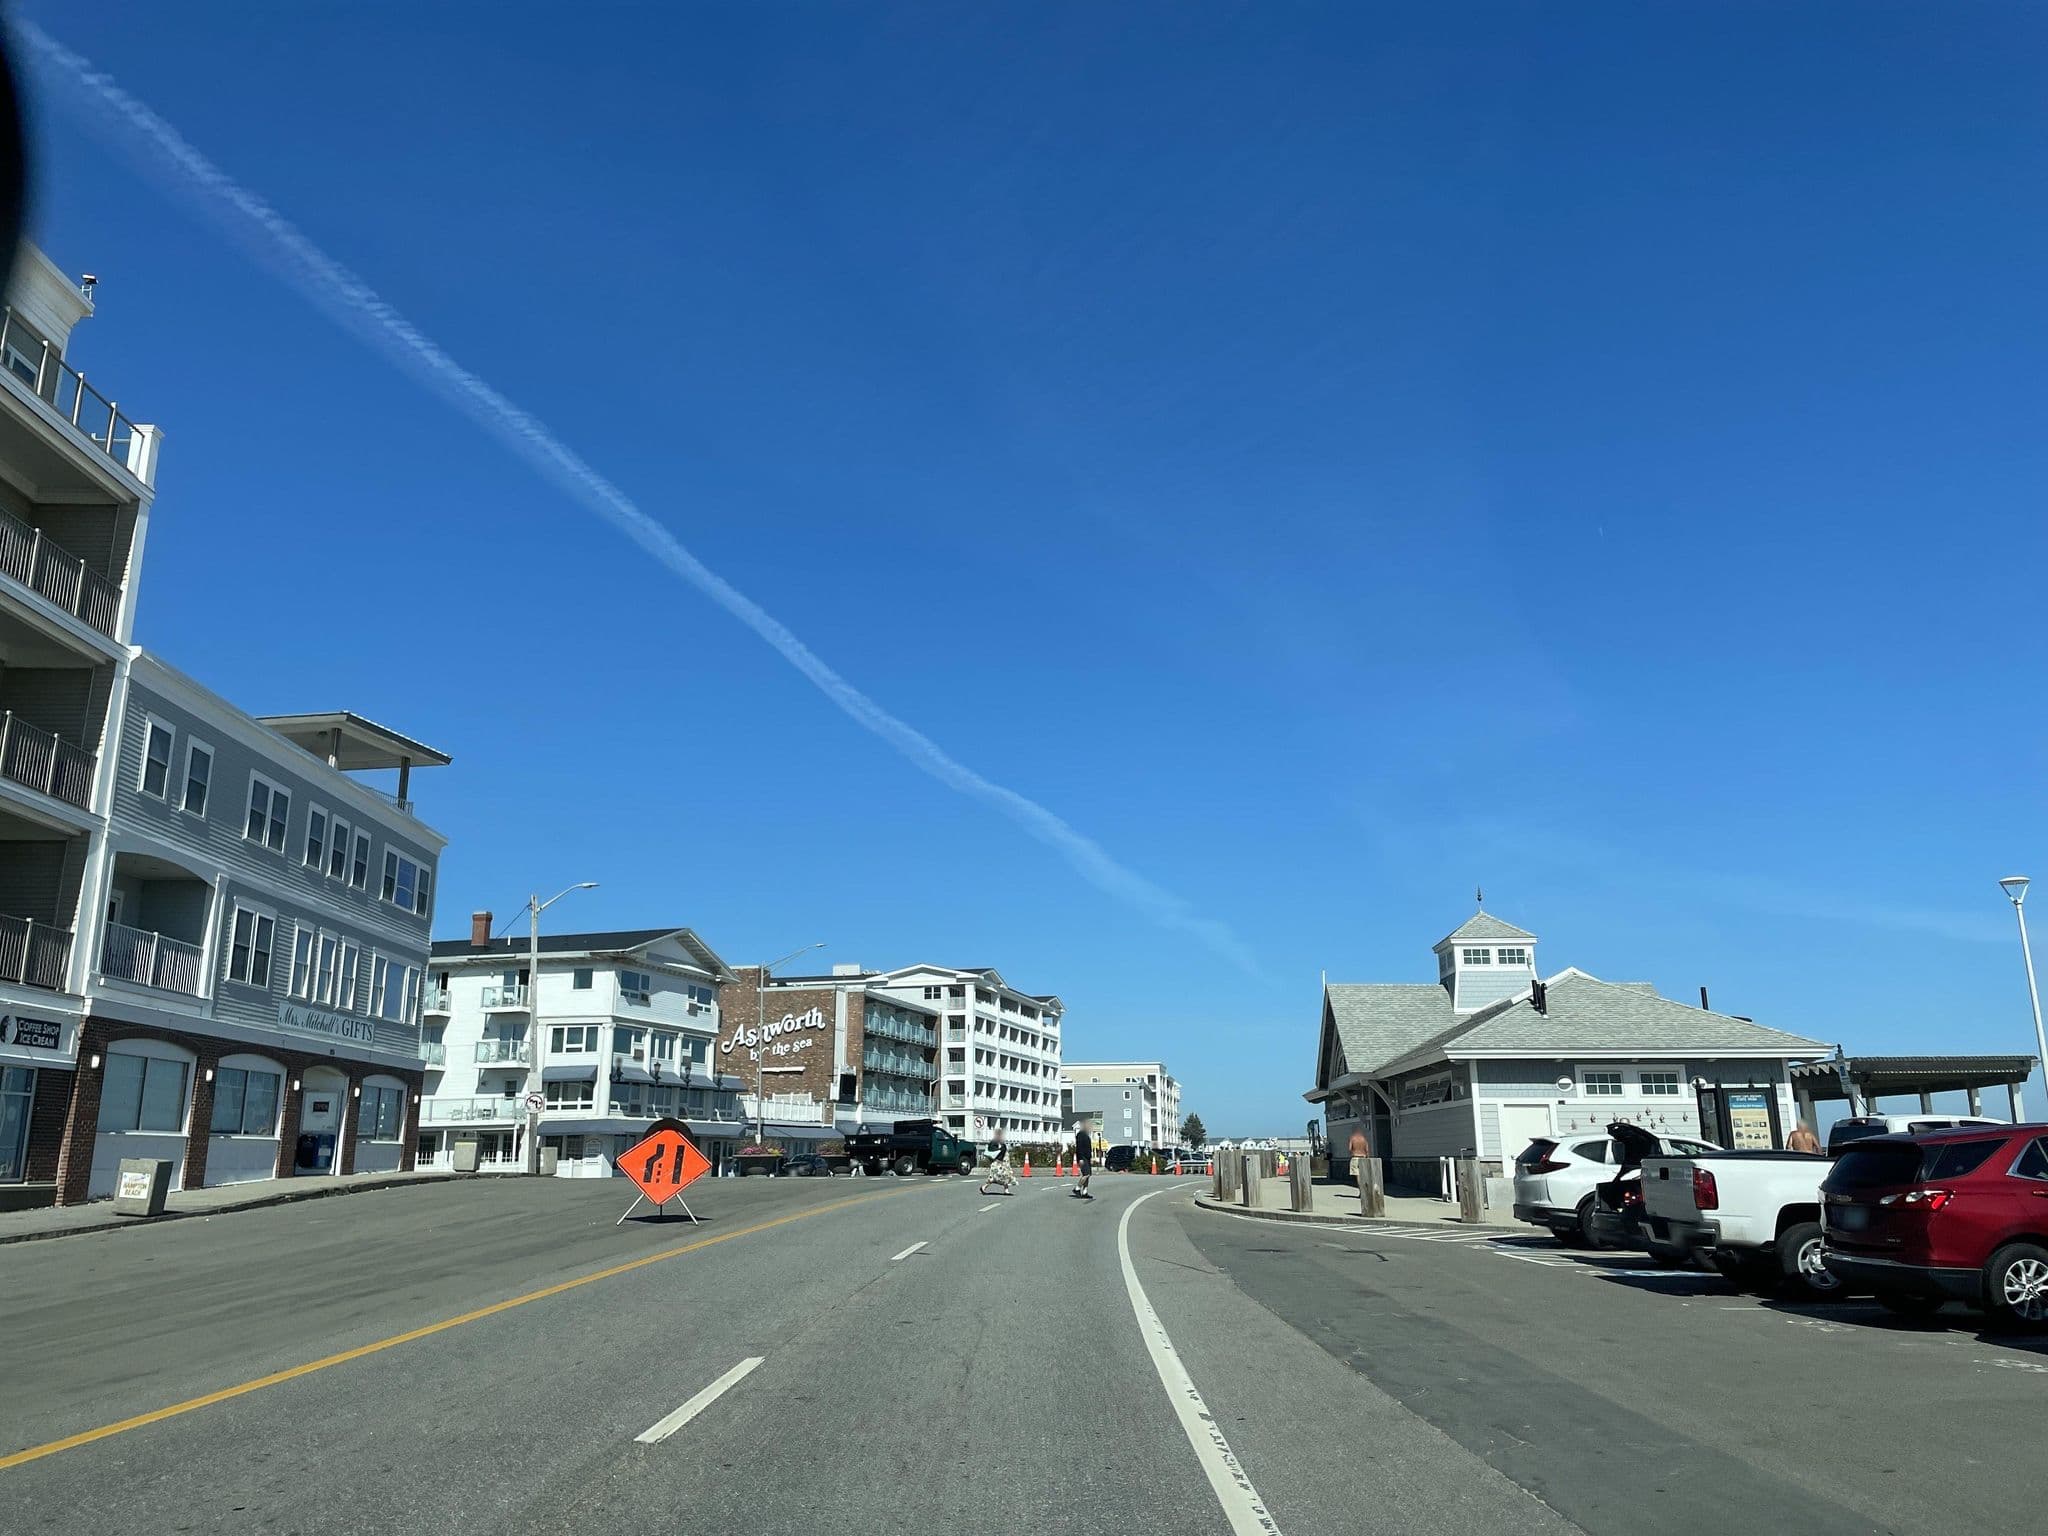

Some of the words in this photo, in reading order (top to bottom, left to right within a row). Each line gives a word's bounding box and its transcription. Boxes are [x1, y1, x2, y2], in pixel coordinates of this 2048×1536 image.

[18, 1020, 42, 1033] COFFEE
[43, 1023, 59, 1036] SHOP
[301, 1012, 339, 1034] Mitchell's
[342, 1019, 373, 1041] GIFTS
[721, 1007, 825, 1053] Ashworth
[19, 1032, 31, 1044] ICE
[32, 1034, 55, 1047] CREAM
[772, 1042, 790, 1056] the
[123, 1182, 147, 1190] HAMPTON
